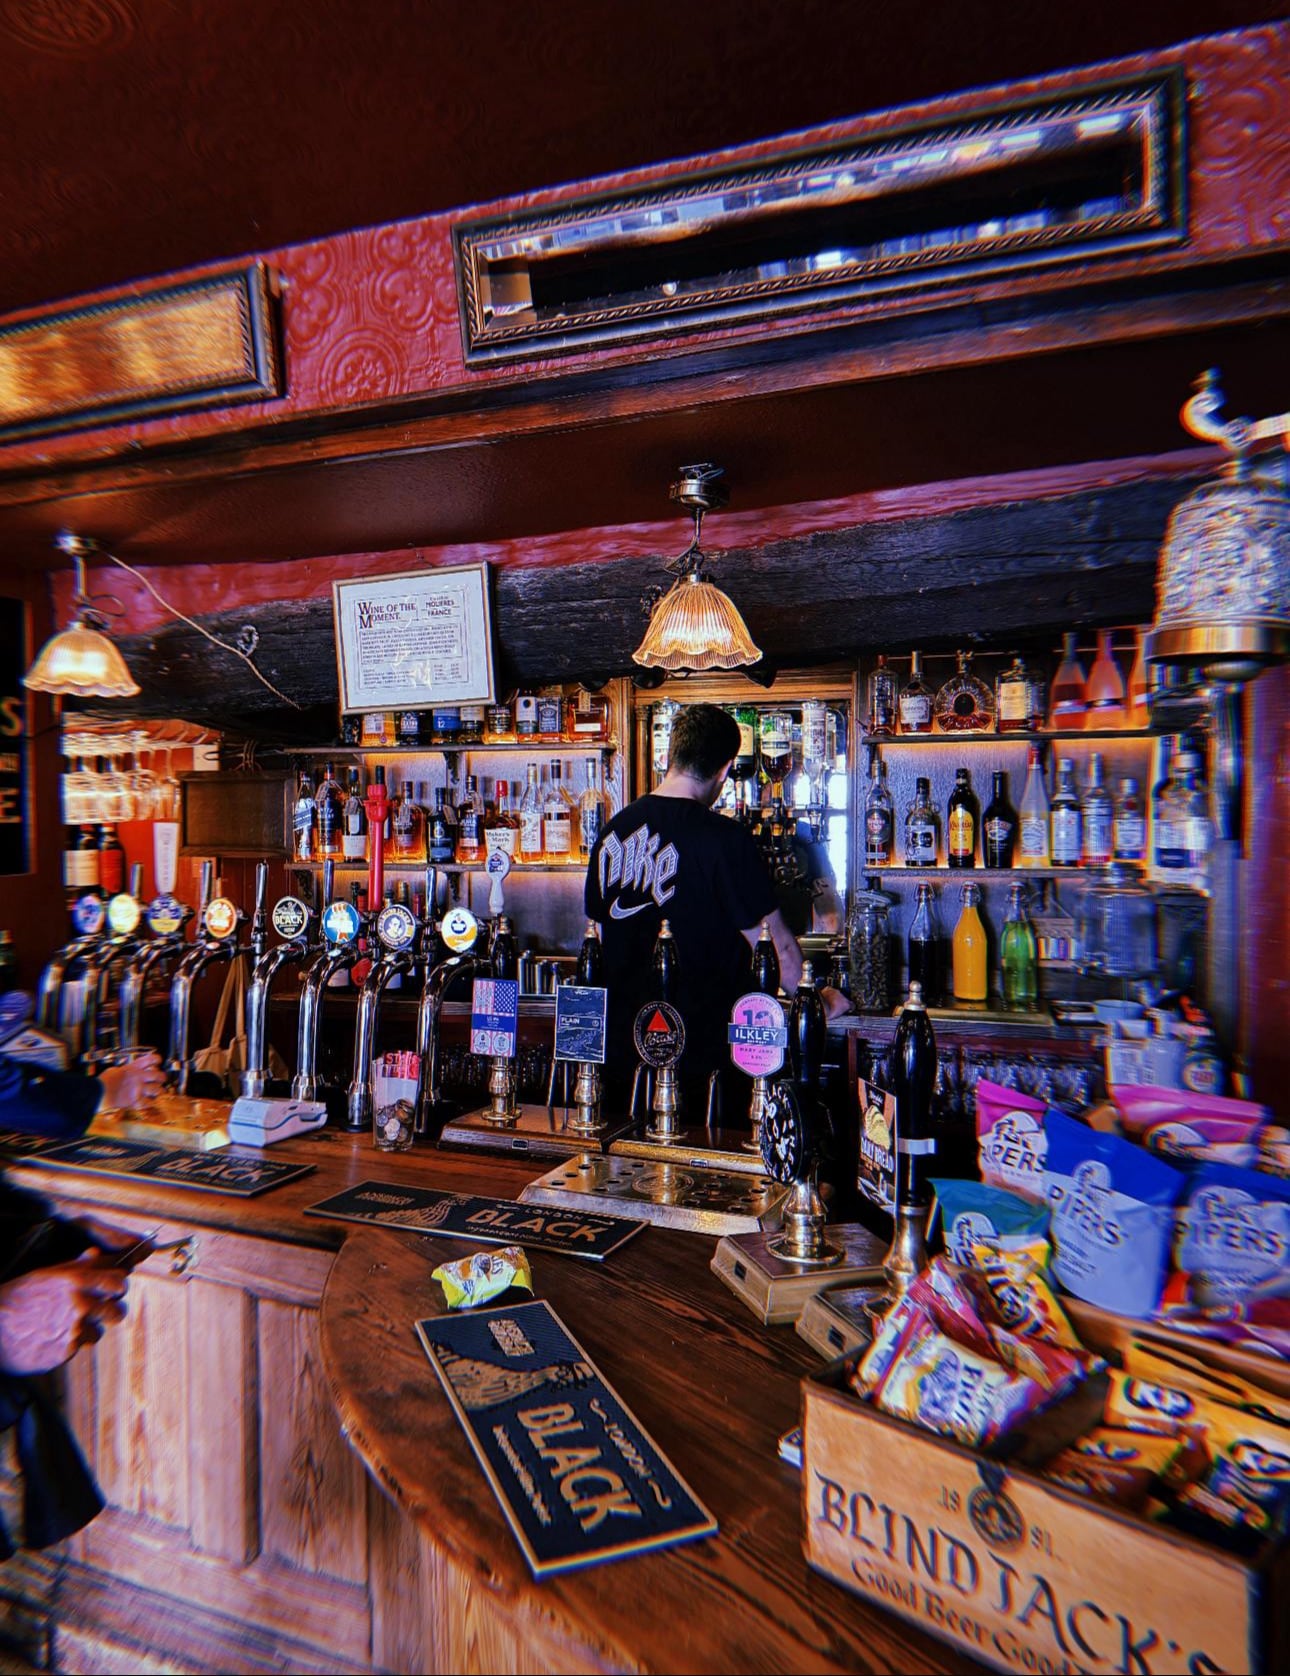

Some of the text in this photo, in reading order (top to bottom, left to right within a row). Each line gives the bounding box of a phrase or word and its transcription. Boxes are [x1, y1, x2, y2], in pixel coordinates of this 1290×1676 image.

[386, 604, 398, 613] OF
[399, 603, 416, 612] THE
[275, 915, 303, 924] BLACK
[561, 1016, 580, 1025] PLAIN
[735, 1028, 779, 1041] ILKLEY
[157, 1158, 275, 1184] BLACK
[524, 1207, 585, 1222] LONDON
[465, 1209, 609, 1244] BLACK
[517, 1402, 643, 1533] BLACK
[813, 1467, 980, 1598] BLIND
[851, 1556, 918, 1612] Good
[919, 1581, 986, 1645] Beer
